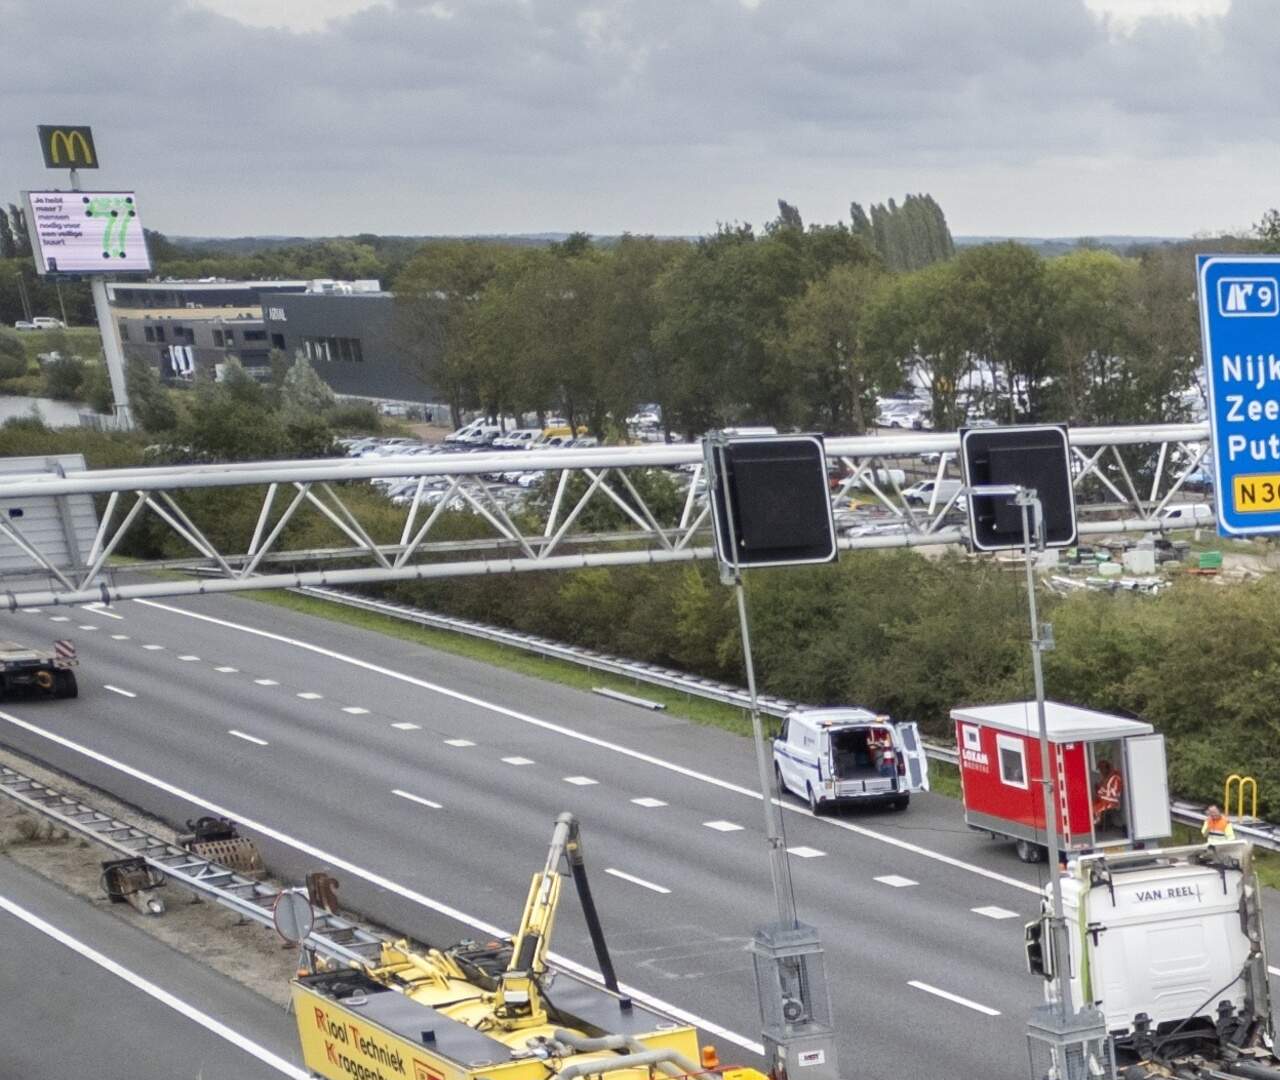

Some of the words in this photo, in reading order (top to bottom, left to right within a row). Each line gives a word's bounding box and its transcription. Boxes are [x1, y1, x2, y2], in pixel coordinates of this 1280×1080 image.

[1258, 286, 1273, 307] 9
[1136, 889, 1162, 901] VAN
[1167, 886, 1195, 898] REEL
[314, 1006, 349, 1045] Riool
[349, 1025, 407, 1075] Techniek
